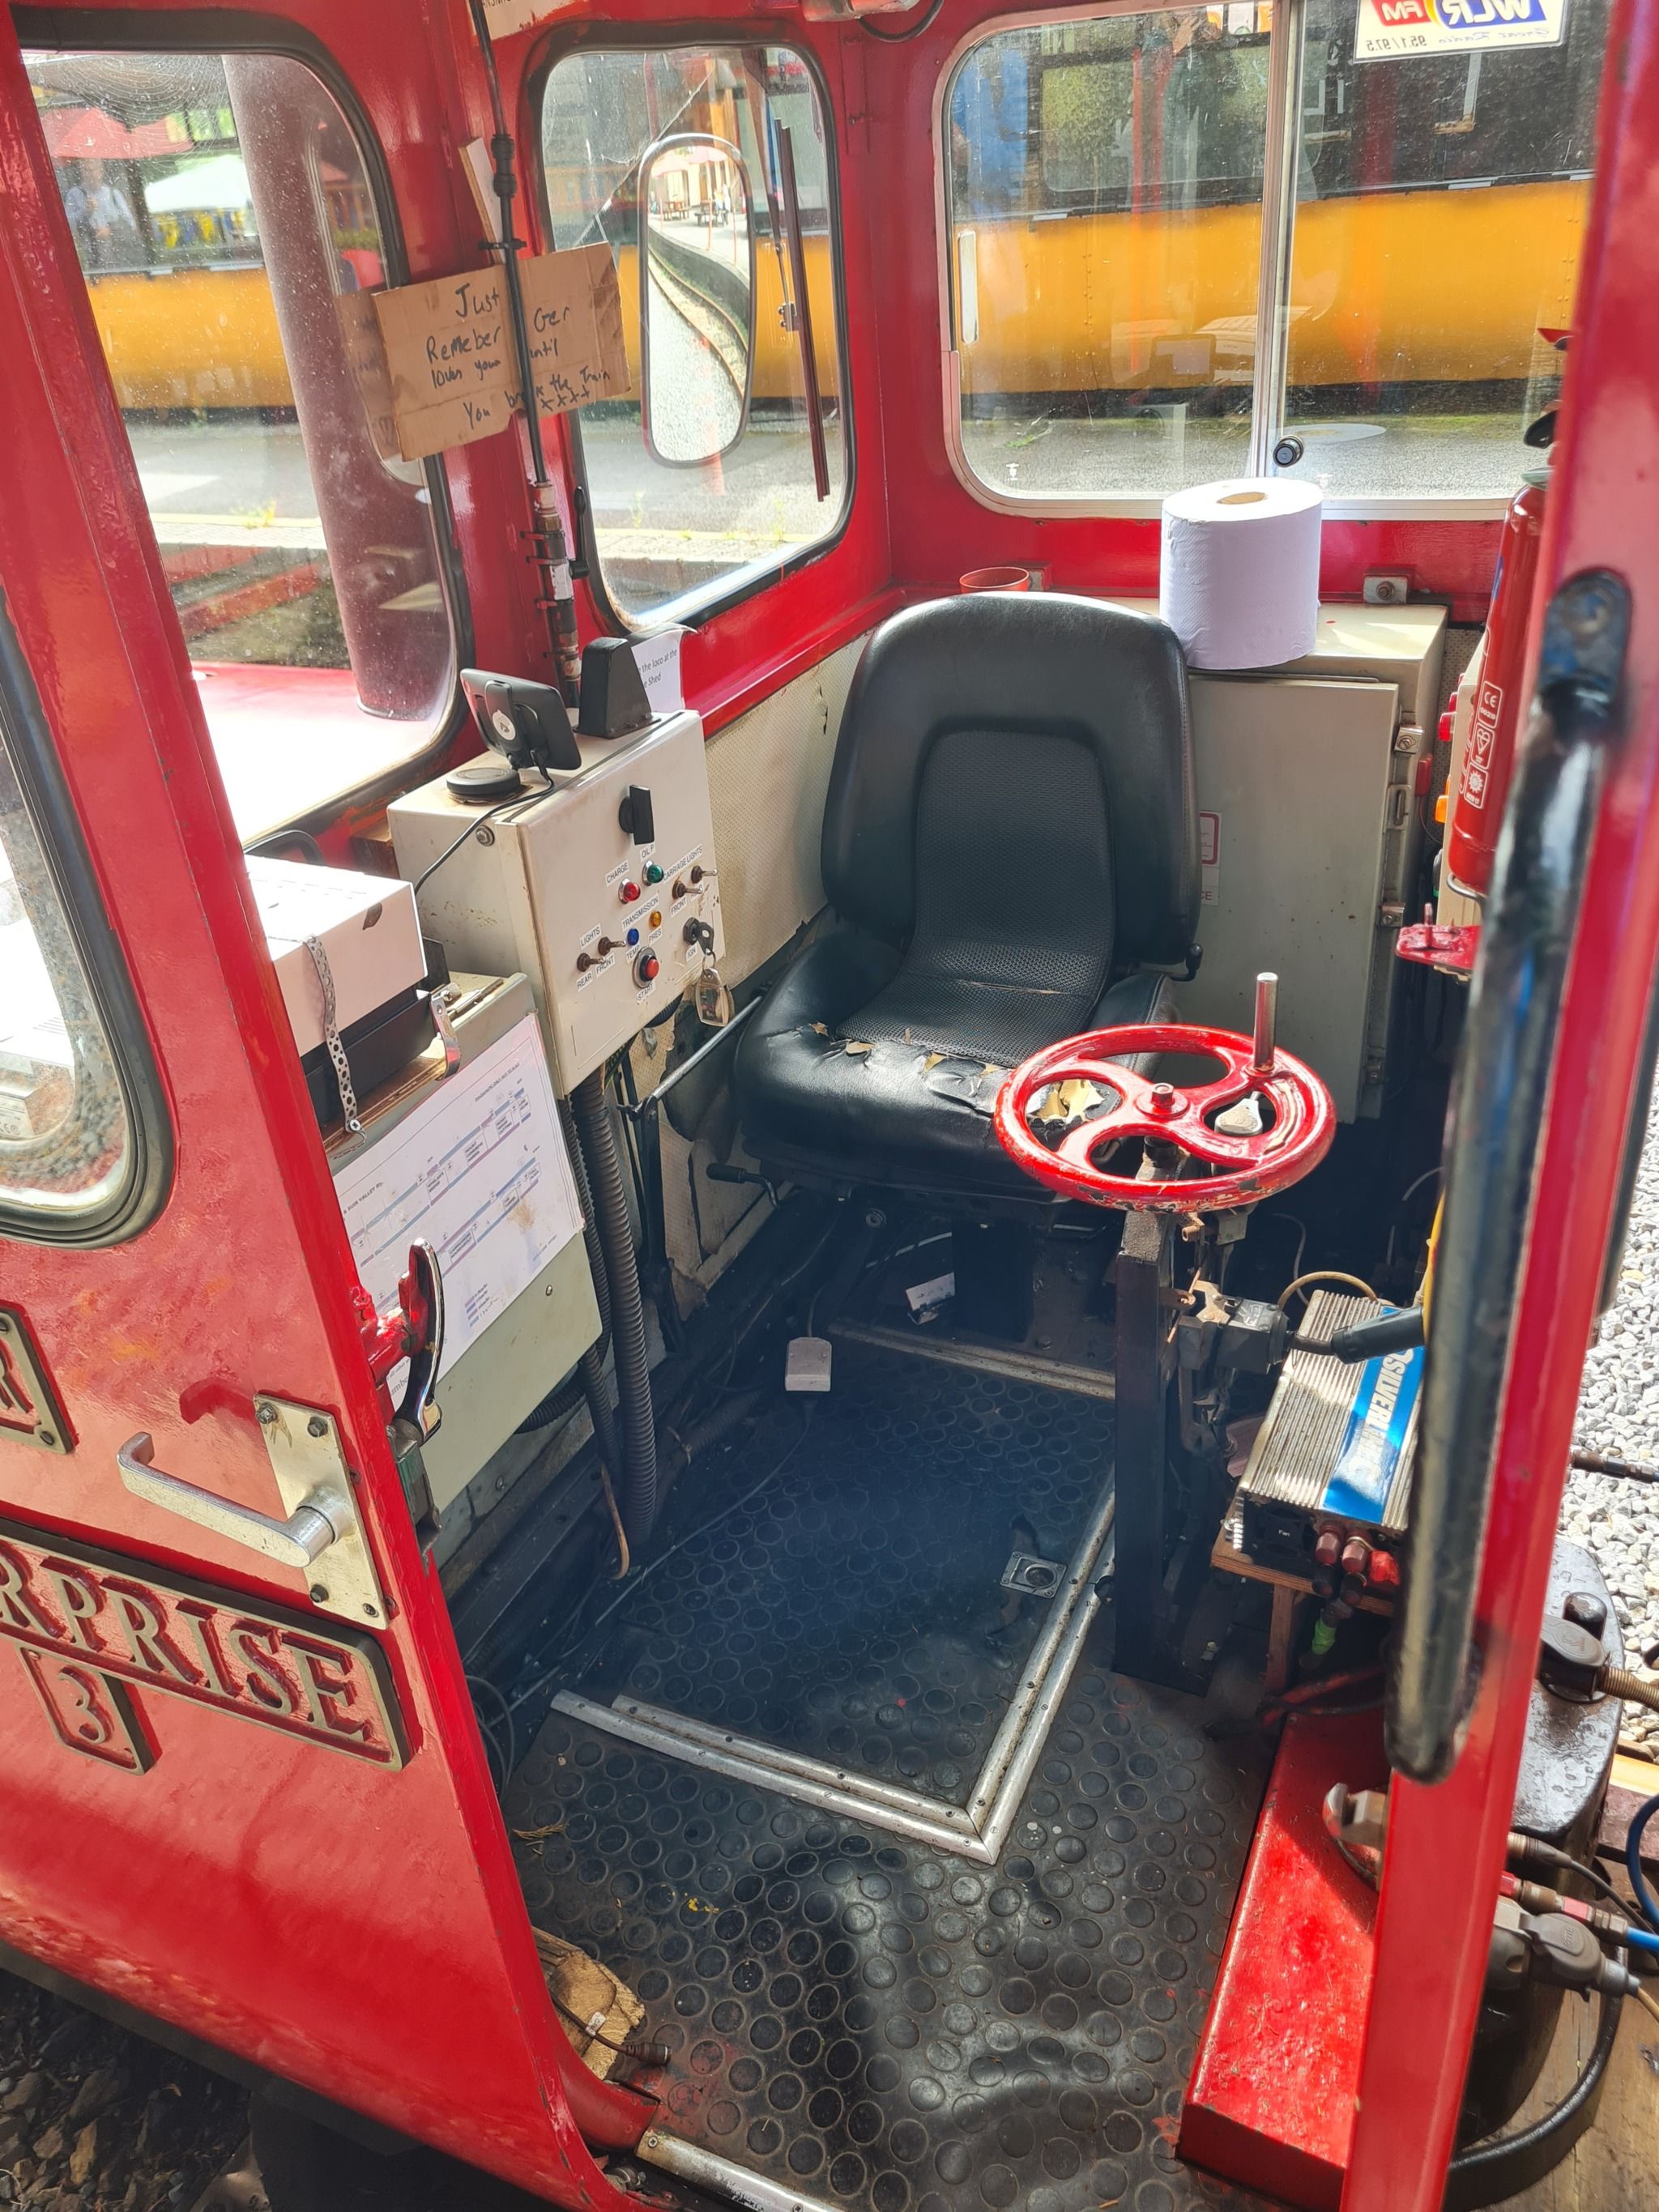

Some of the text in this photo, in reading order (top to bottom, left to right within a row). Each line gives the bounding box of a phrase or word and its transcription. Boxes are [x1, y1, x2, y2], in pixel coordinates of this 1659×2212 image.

[454, 283, 500, 318] Just
[426, 306, 569, 364] Remeber Ger
[463, 402, 491, 429] You
[550, 373, 570, 392] the
[579, 364, 611, 382] Train
[652, 657, 663, 668] loco
[648, 671, 662, 686] Shed
[641, 849, 650, 859] OIL
[663, 845, 702, 881] CARRIAGE LIGHTS
[607, 862, 629, 883] CHARGE
[622, 896, 659, 928] TRANSMISSION
[671, 897, 687, 914] FRONT
[580, 927, 600, 946] LIGHTS
[649, 928, 662, 943] PRES
[595, 957, 614, 974] FRONT
[577, 974, 592, 989] REAR
[637, 983, 654, 1001] START
[358, 1186, 376, 1201] VALLEY
[0, 1541, 370, 1743] RPRISE
[58, 1664, 114, 1744] 3
